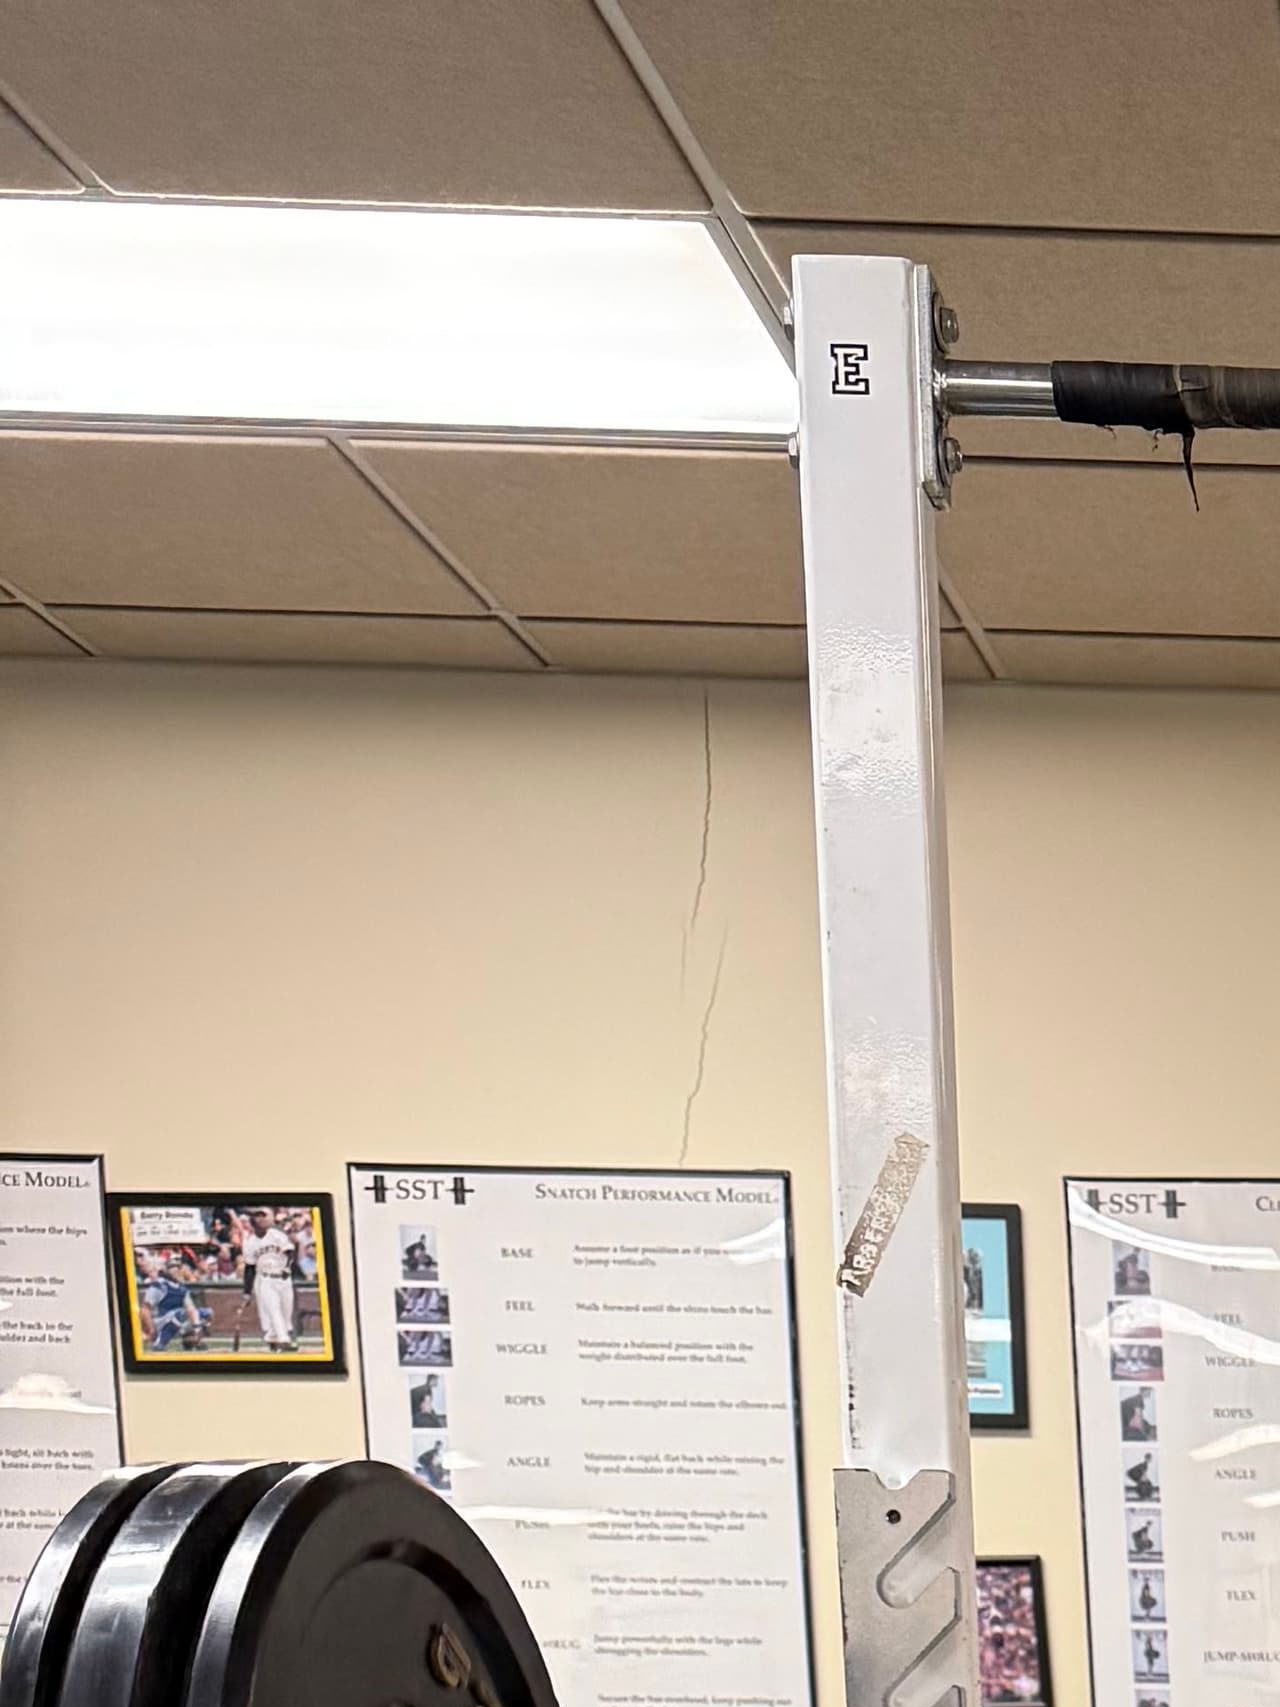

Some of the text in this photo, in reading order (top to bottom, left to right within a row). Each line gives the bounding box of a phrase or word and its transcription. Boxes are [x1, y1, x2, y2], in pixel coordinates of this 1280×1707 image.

[830, 344, 870, 395] E
[395, 1180, 445, 1200] SST
[1109, 1193, 1157, 1214] SST
